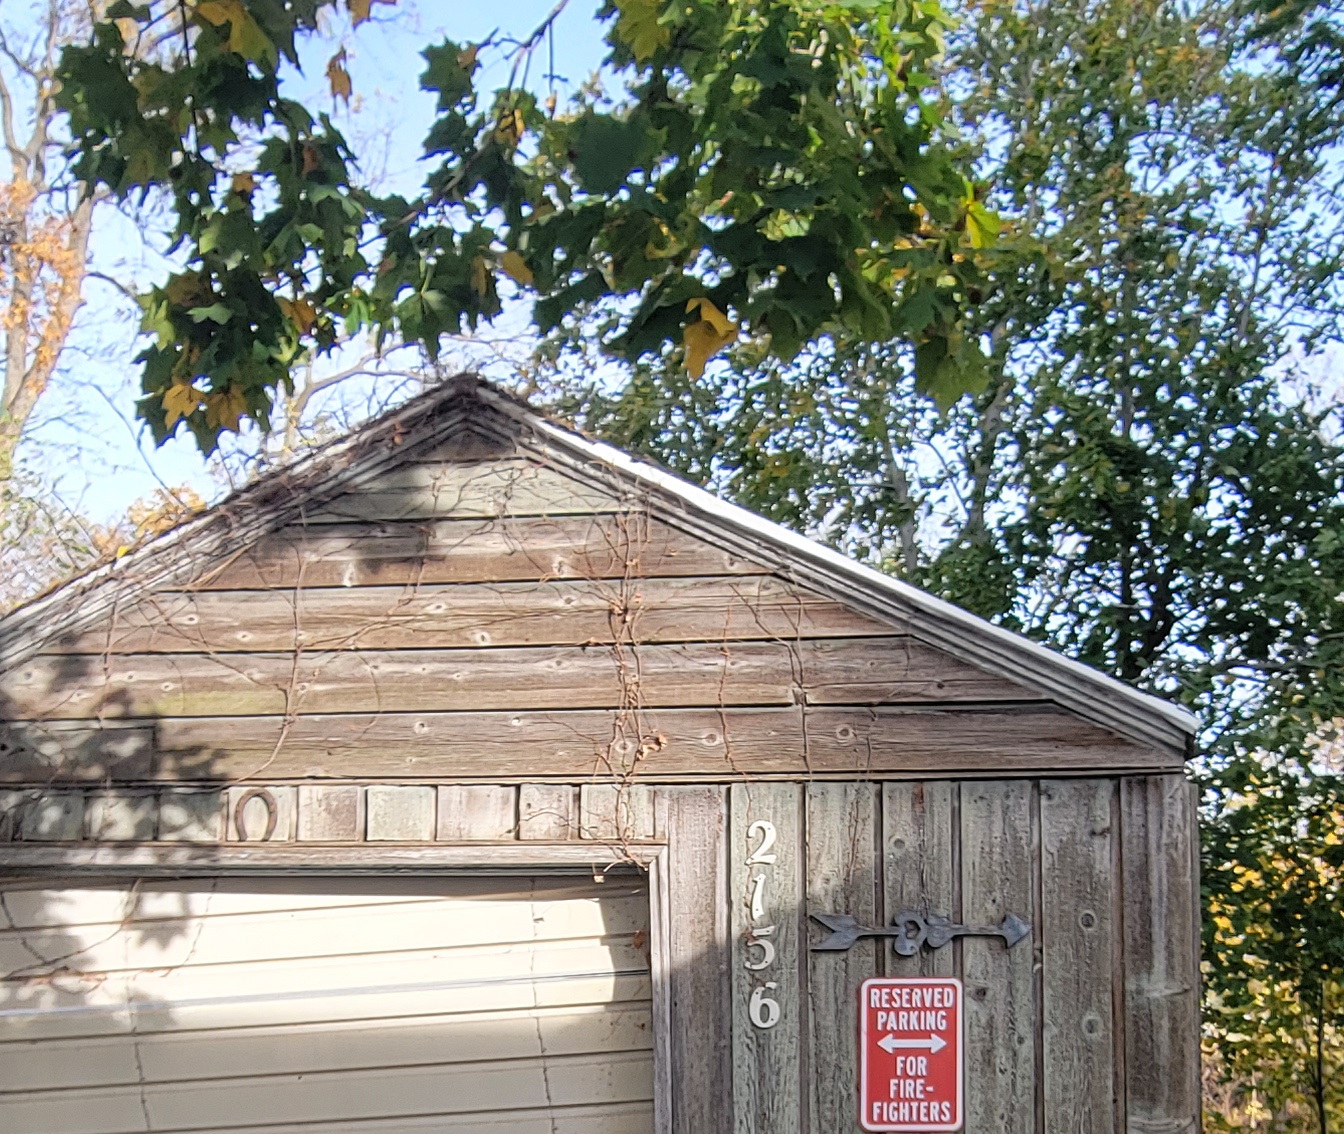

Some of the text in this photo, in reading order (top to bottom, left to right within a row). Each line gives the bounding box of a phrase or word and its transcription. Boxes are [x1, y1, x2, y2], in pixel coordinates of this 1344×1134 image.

[744, 819, 781, 1029] 2156
[870, 988, 954, 1008] RESERVED
[876, 1010, 947, 1031] PARKING
[896, 1056, 927, 1076] FOR
[889, 1078, 934, 1099] FIRE-
[872, 1101, 951, 1122] FIGHTERS
